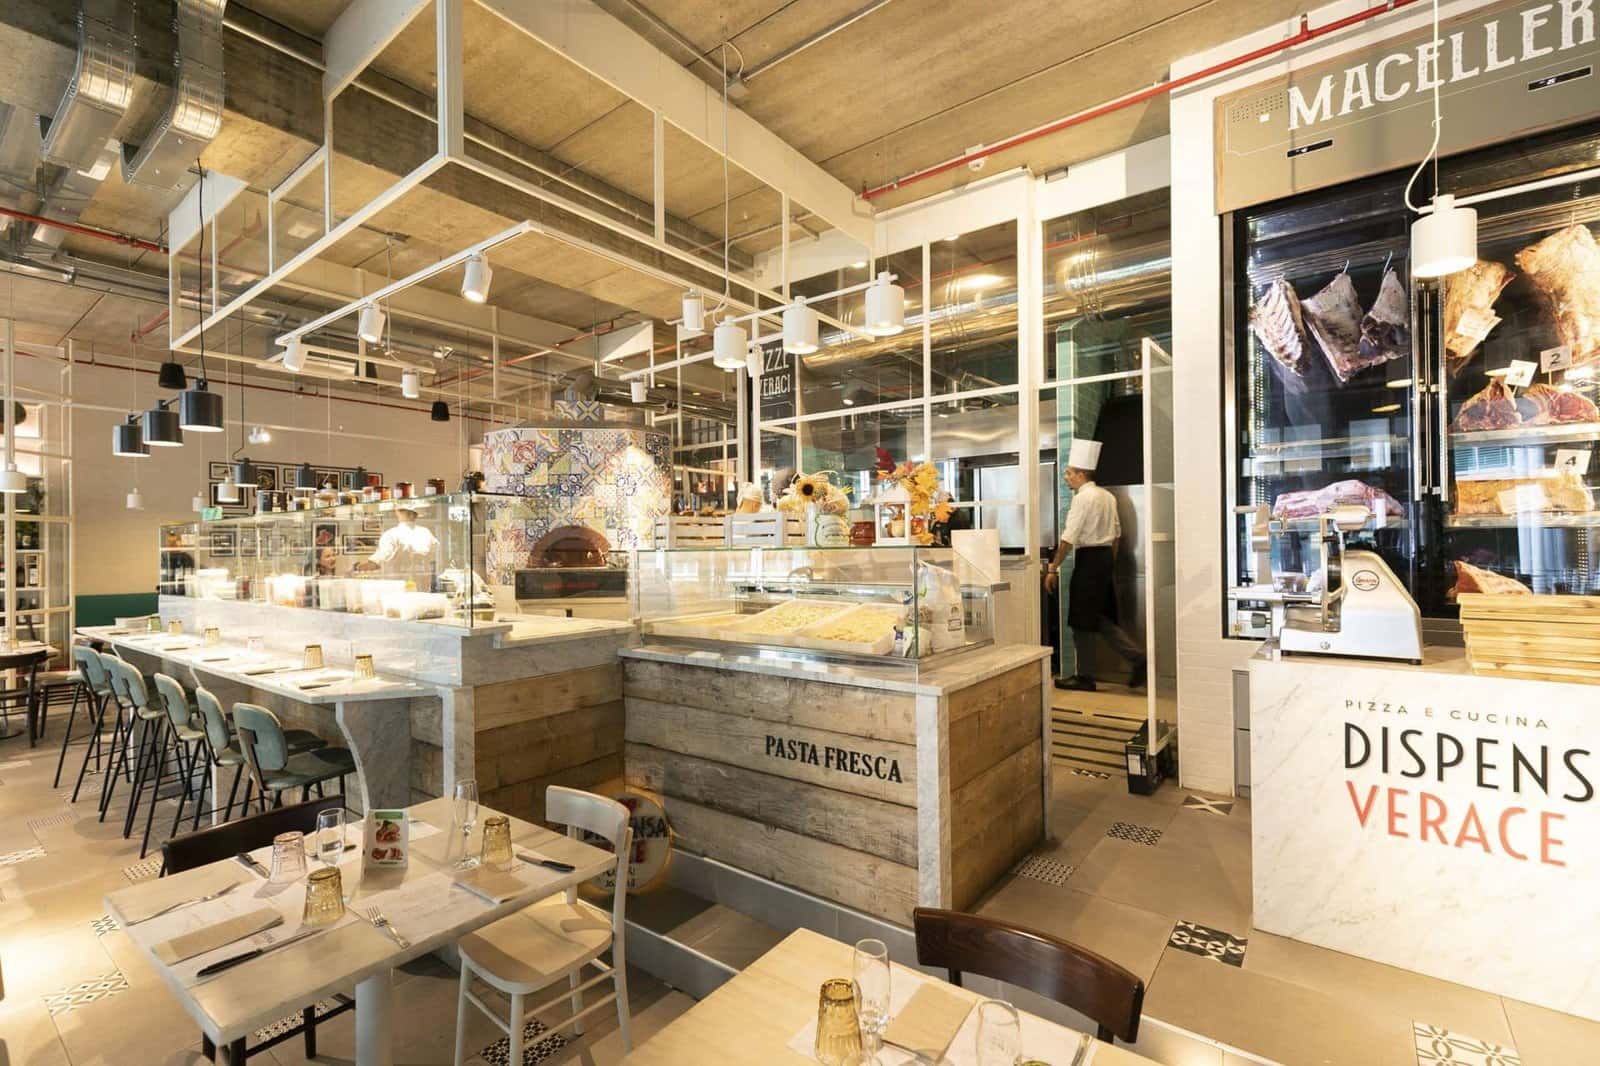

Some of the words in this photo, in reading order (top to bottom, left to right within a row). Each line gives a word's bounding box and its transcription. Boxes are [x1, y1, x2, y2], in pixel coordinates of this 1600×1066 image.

[1287, 0, 1596, 131] MACELLER
[1551, 352, 1561, 365] 2
[1565, 455, 1577, 467] 4
[1345, 699, 1408, 715] PIZZA
[1424, 707, 1434, 718] E
[1450, 709, 1549, 729] CUCINA
[765, 735, 819, 766] PASTA
[824, 746, 903, 783] FRESCA
[1344, 722, 1594, 803] DISPENS
[1345, 780, 1567, 867] VERACE
